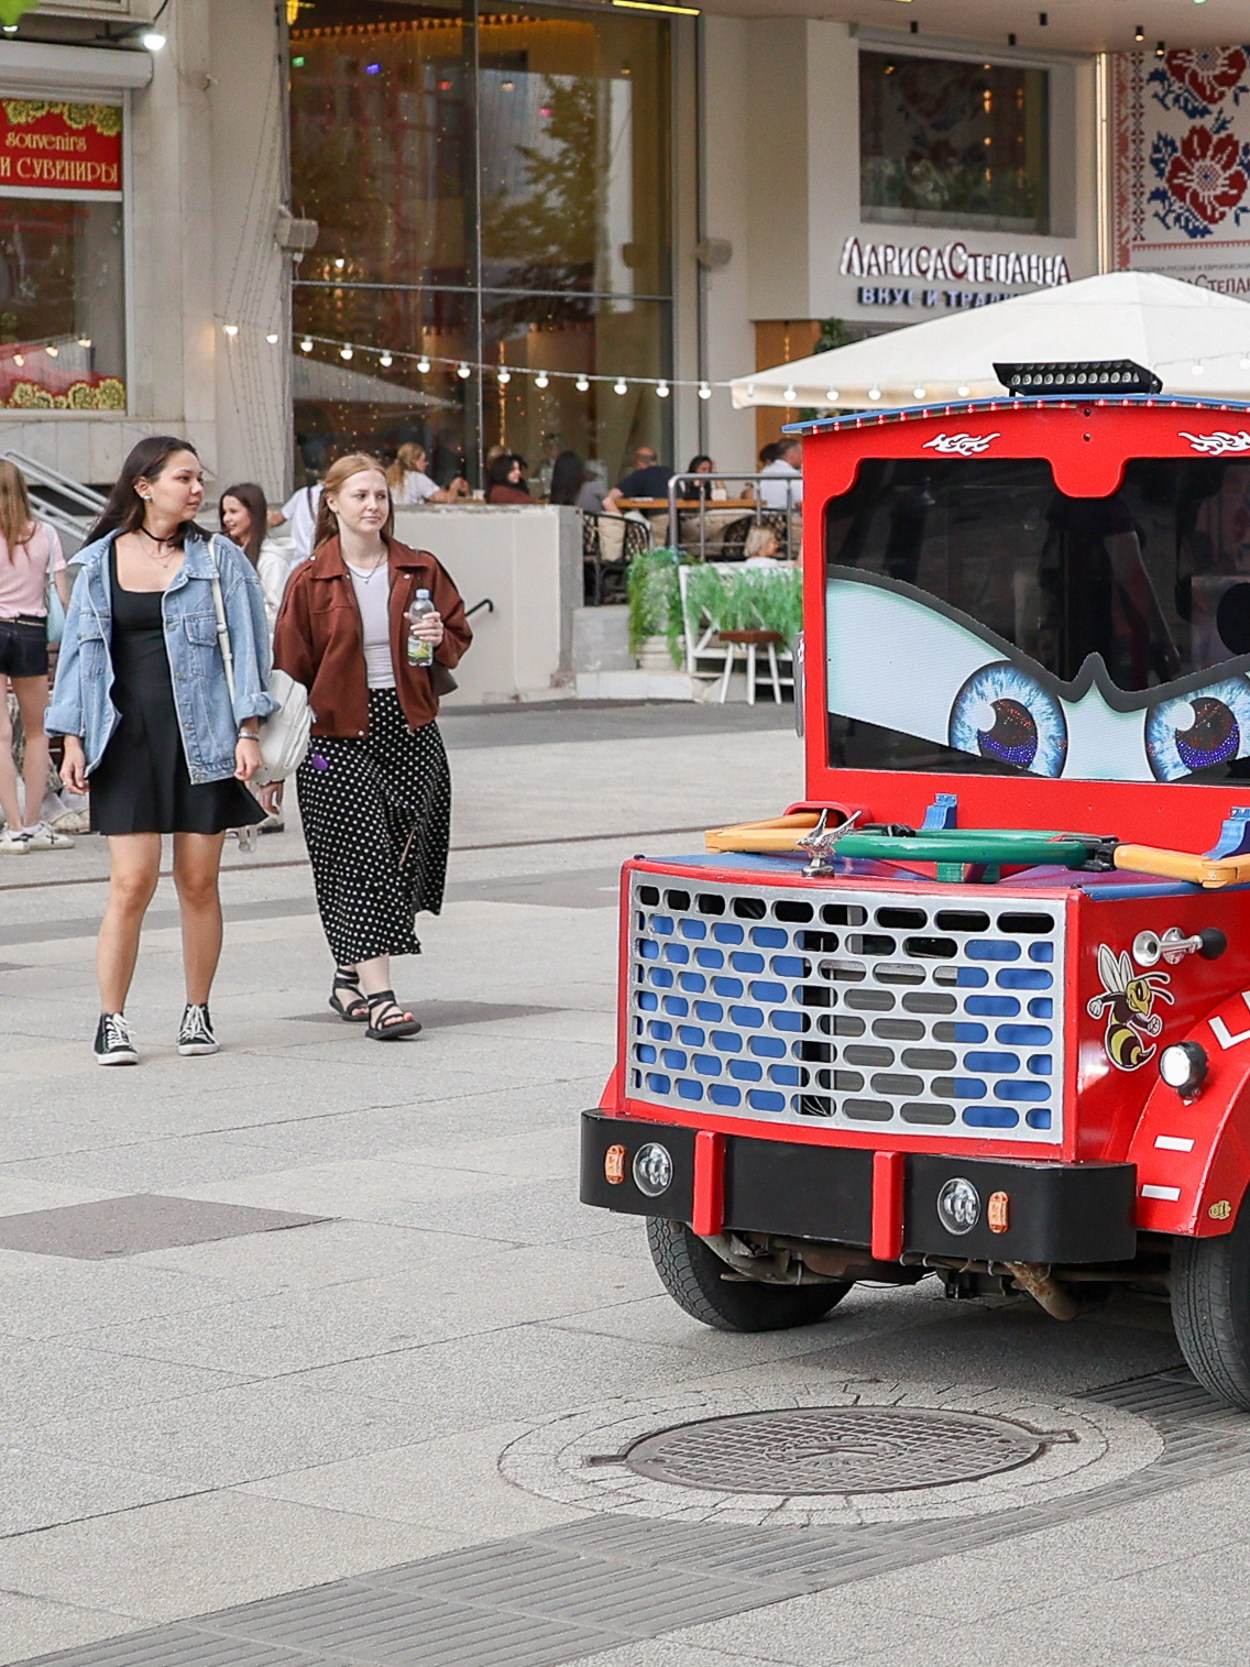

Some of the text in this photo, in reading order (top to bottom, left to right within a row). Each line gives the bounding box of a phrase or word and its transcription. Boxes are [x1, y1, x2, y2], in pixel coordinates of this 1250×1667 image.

[5, 131, 87, 153] souvenirs
[0, 156, 119, 184] И СУВЕНИРЫ
[922, 289, 940, 308] И
